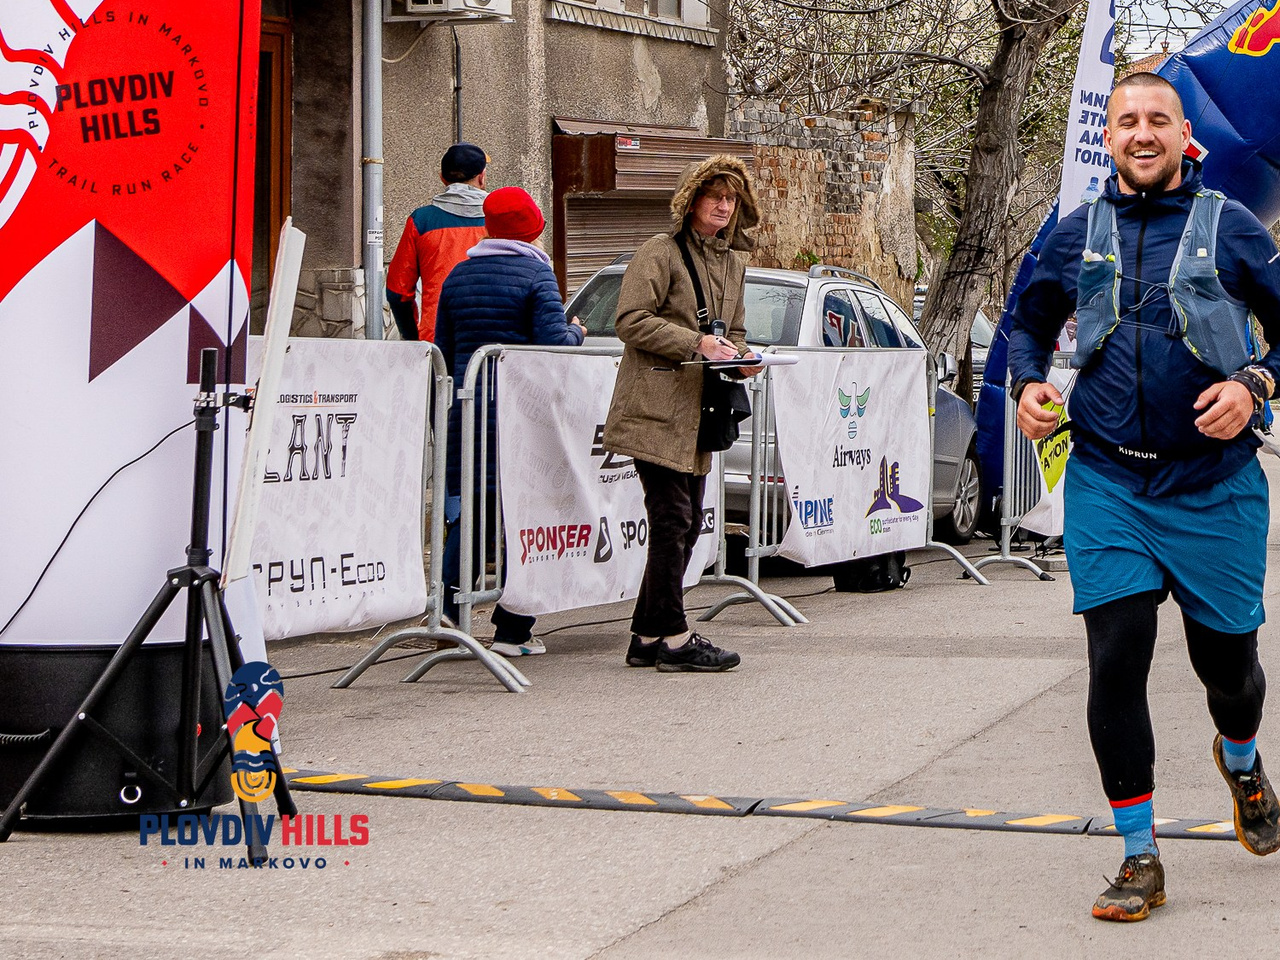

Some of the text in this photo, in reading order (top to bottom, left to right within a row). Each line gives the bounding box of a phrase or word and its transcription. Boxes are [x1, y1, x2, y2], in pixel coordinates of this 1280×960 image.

[27, 11, 209, 130] PLOVDIV HILLS IN MARKOVO
[55, 70, 175, 112] PLOVDIV
[80, 108, 161, 143] HILLS
[48, 142, 199, 196] TRAIL RUN RACE
[276, 393, 313, 404] OGISTICS
[318, 393, 358, 404] TRANSPORT
[832, 444, 872, 470] Airways
[1118, 445, 1157, 460] KIPRUN
[520, 524, 592, 566] SPONSER
[620, 518, 648, 550] SPO
